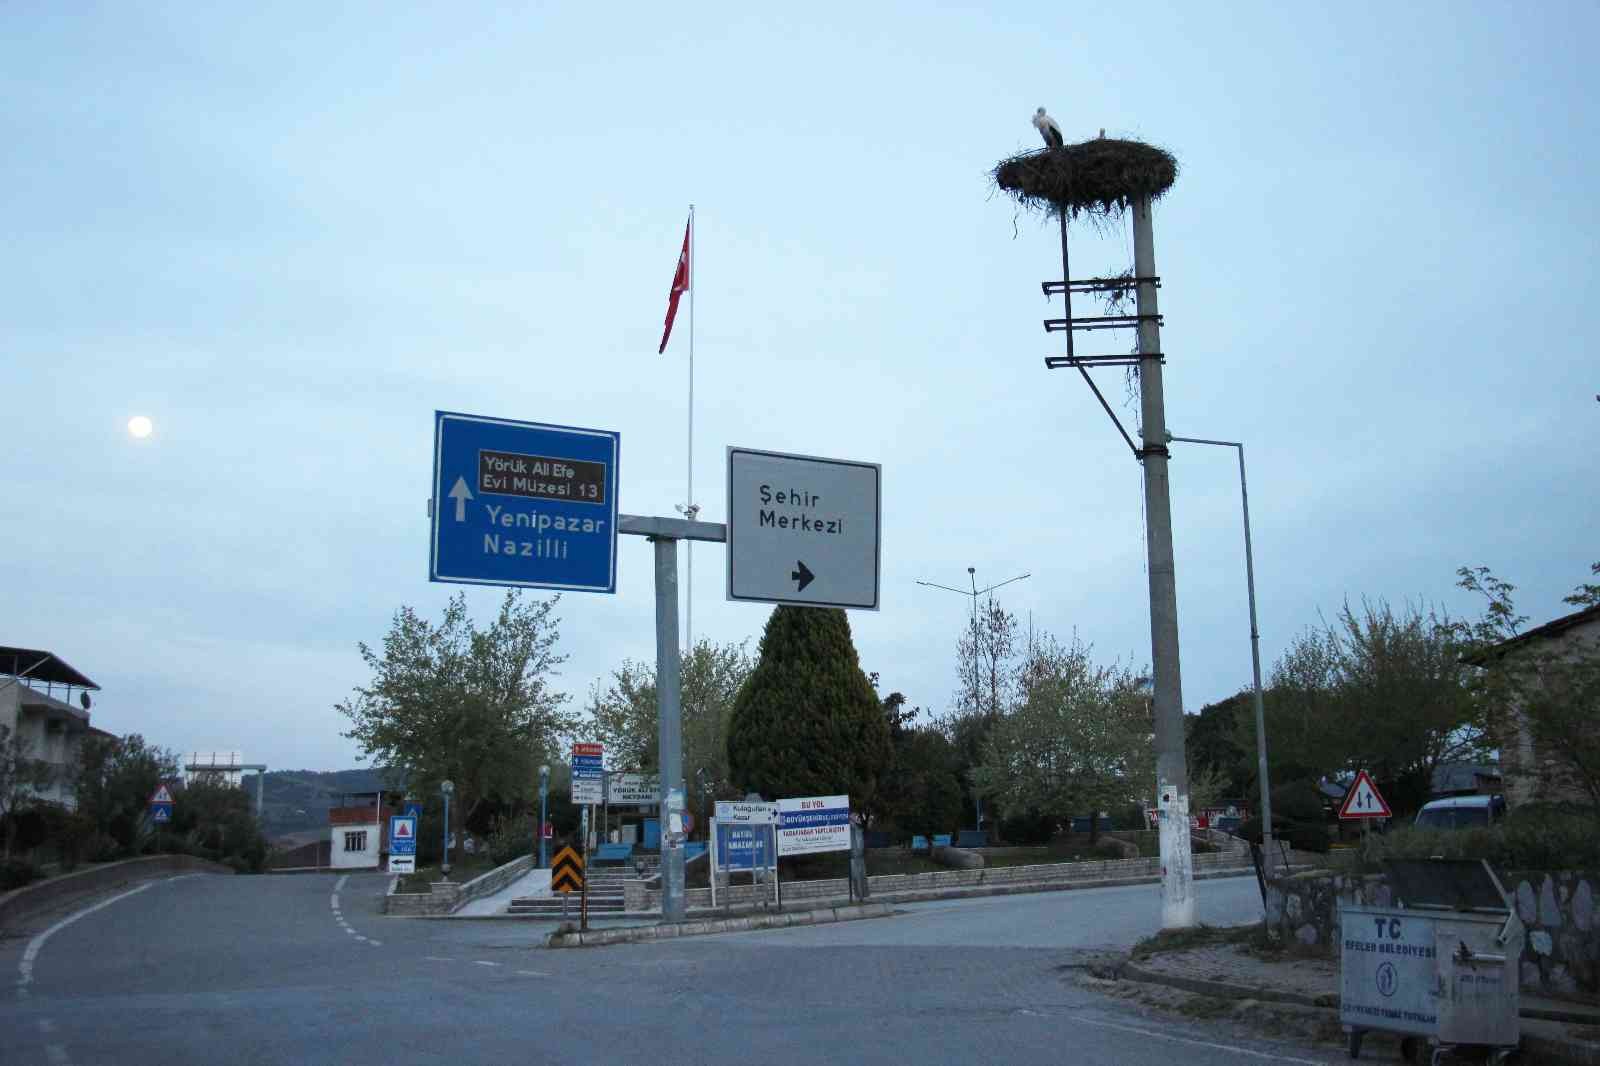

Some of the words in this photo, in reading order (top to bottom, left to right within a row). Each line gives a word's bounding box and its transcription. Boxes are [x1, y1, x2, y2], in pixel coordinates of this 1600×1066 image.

[485, 456, 527, 473] Yörük
[532, 461, 549, 475] Ali
[553, 463, 576, 479] Efe
[483, 475, 506, 489] Evi
[579, 484, 598, 498] 13
[759, 484, 820, 508] Şehir
[485, 505, 605, 534] Yenipazar
[759, 509, 842, 534] Merkezi
[483, 534, 568, 559] Nazilli
